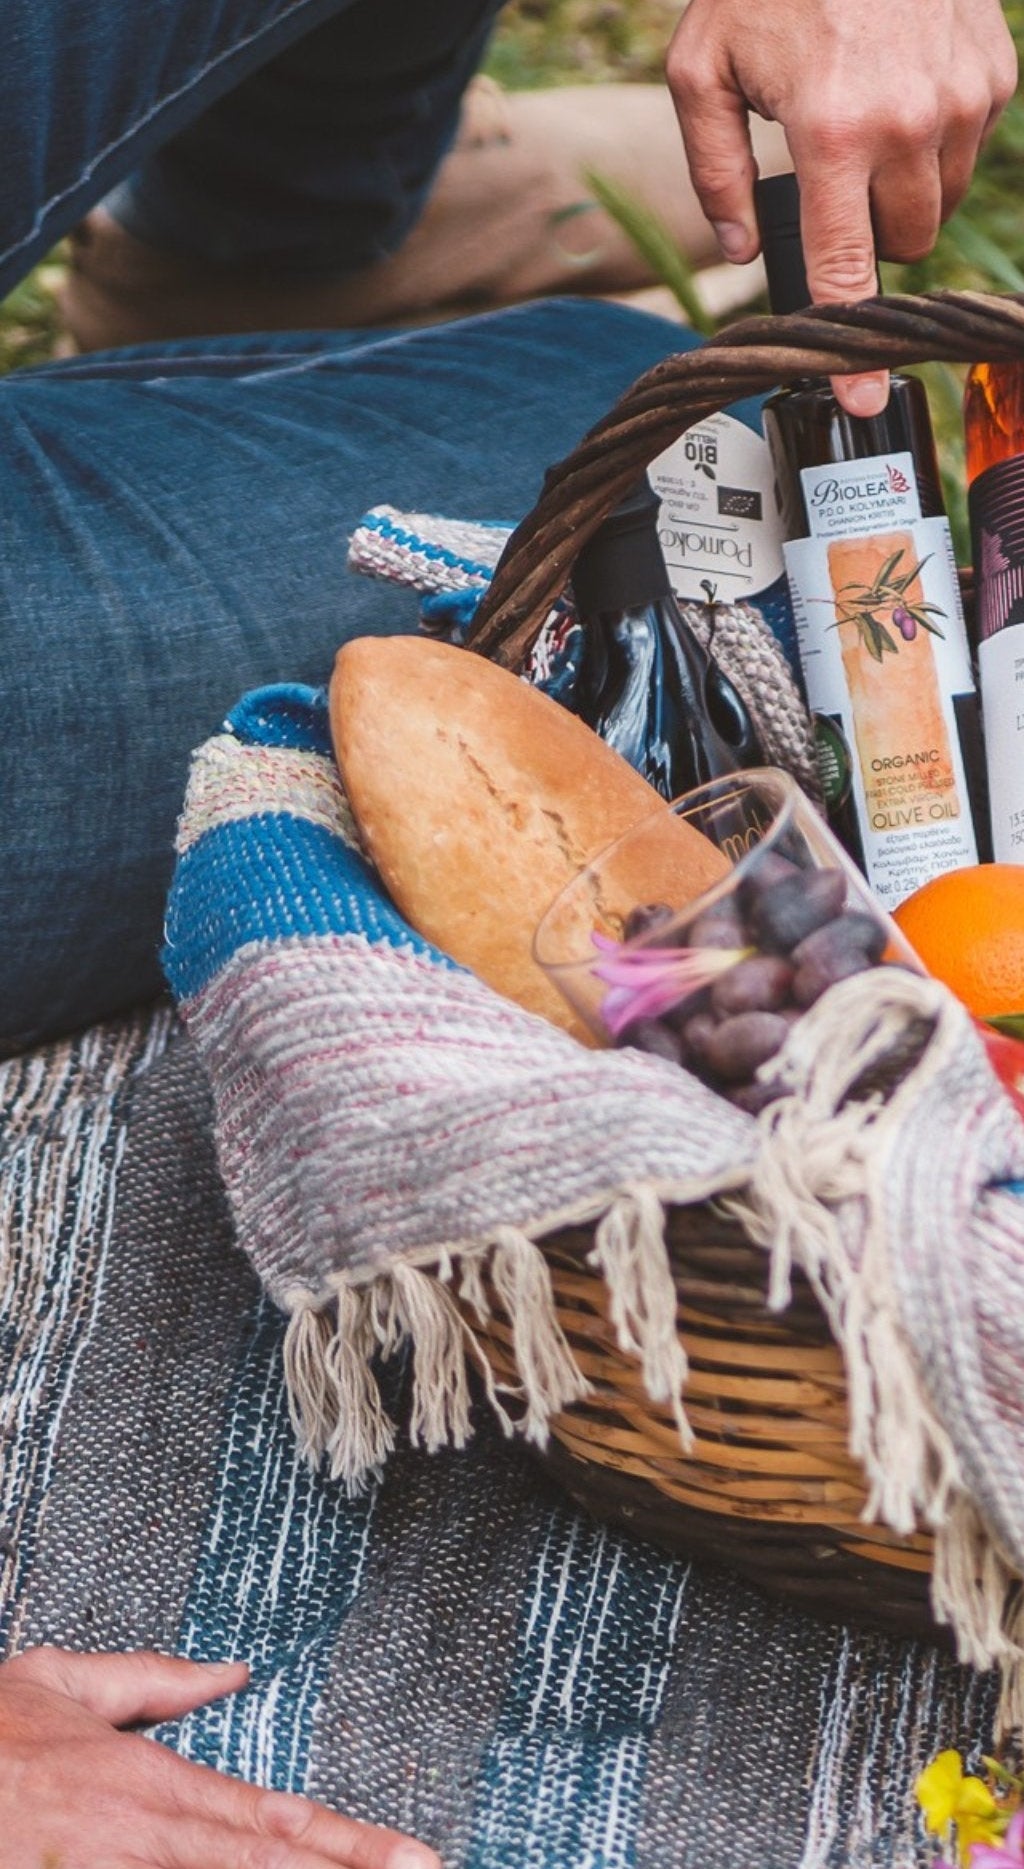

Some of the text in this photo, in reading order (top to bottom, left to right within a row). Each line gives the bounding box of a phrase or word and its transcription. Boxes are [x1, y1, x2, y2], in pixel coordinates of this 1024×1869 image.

[685, 442, 718, 465] BIO
[848, 496, 907, 513] KOLYMVARI
[657, 528, 753, 569] Pamako
[871, 749, 941, 773] ORGANIC
[875, 768, 941, 787] STONE MILLED
[887, 783, 916, 795] COLD
[876, 792, 944, 809] EXTRA VIRGIN
[872, 801, 958, 830] OLIVE OIL
